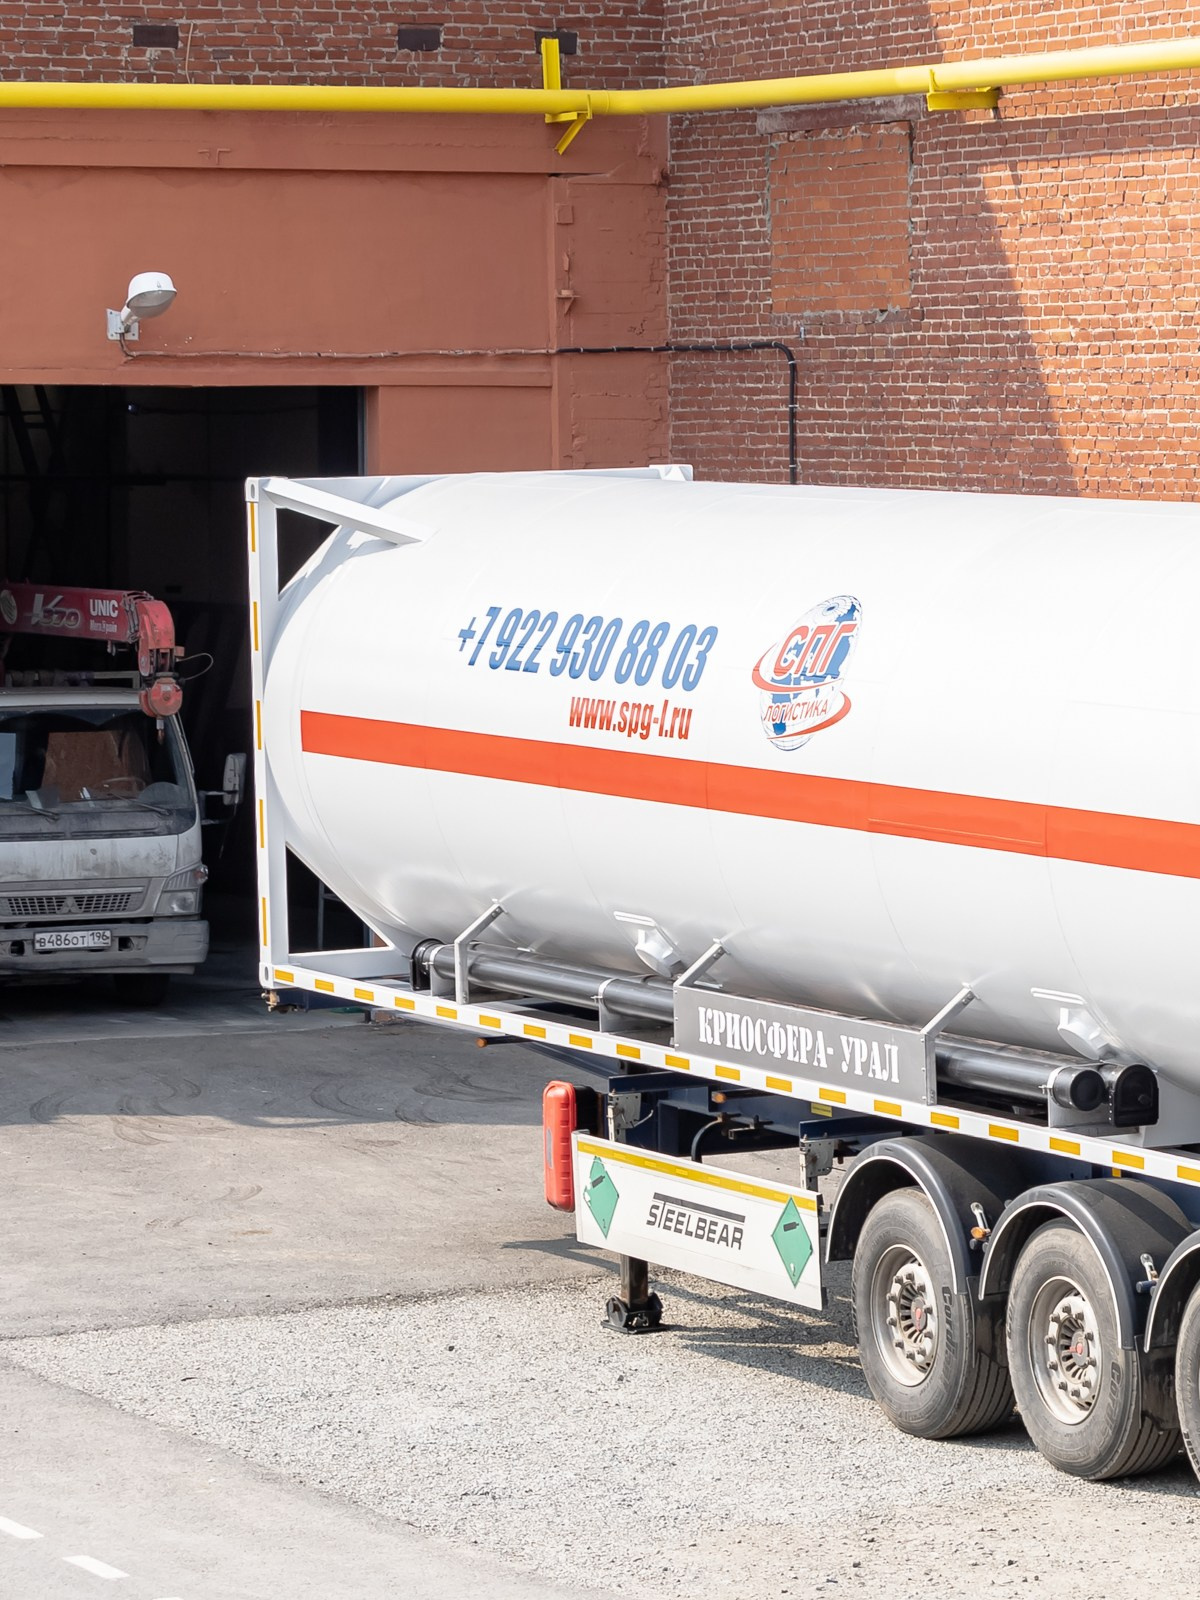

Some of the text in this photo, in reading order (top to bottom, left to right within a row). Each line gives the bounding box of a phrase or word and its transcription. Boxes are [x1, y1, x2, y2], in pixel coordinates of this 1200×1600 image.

[89, 598, 119, 618] UNIC
[458, 606, 719, 693] +7 922 930 88 03
[773, 623, 858, 676] СПГ
[568, 695, 694, 741] www.spg-l.ru
[763, 699, 828, 723] ЛОГИСТИКА
[90, 931, 109, 942] 196
[698, 1006, 900, 1084] КРИОСФЕРА- УРАЛ
[646, 1192, 746, 1251] STEELBEAR
